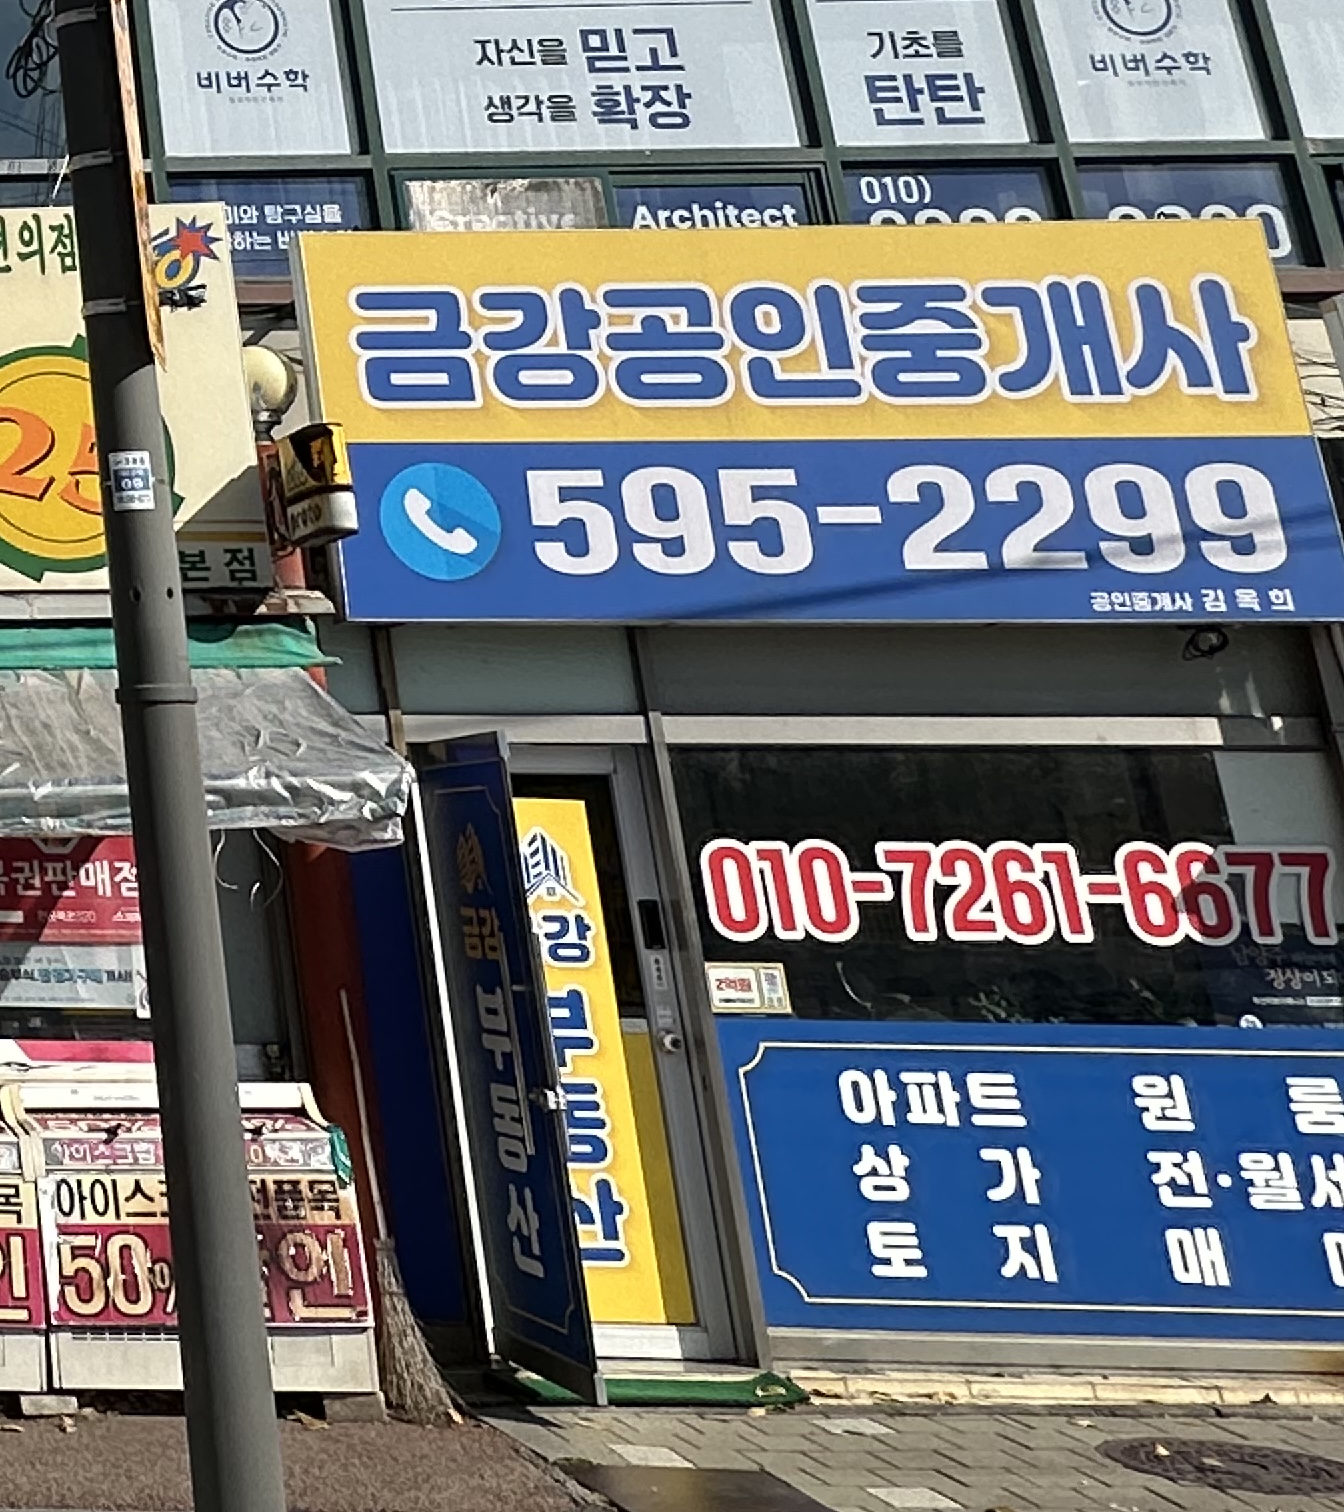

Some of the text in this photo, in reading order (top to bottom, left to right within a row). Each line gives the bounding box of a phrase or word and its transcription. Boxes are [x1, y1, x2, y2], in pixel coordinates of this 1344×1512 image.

[474, 26, 685, 75] 자신을 믿고
[869, 29, 964, 61] 기초를
[1088, 50, 1211, 77] 비버수학
[196, 67, 311, 94] 비버수학
[864, 71, 986, 127] 탄탄
[483, 82, 693, 131] 생각을 확장
[860, 175, 932, 204] 010)
[632, 199, 799, 229] Architect
[230, 231, 272, 250] 하는
[349, 273, 1260, 409] 금강공인중개사
[525, 462, 1290, 577] 595-2299
[1090, 591, 1194, 613] 공인중개사
[701, 838, 1338, 946] 010-7261-6677
[839, 1067, 1028, 1128] 아파트
